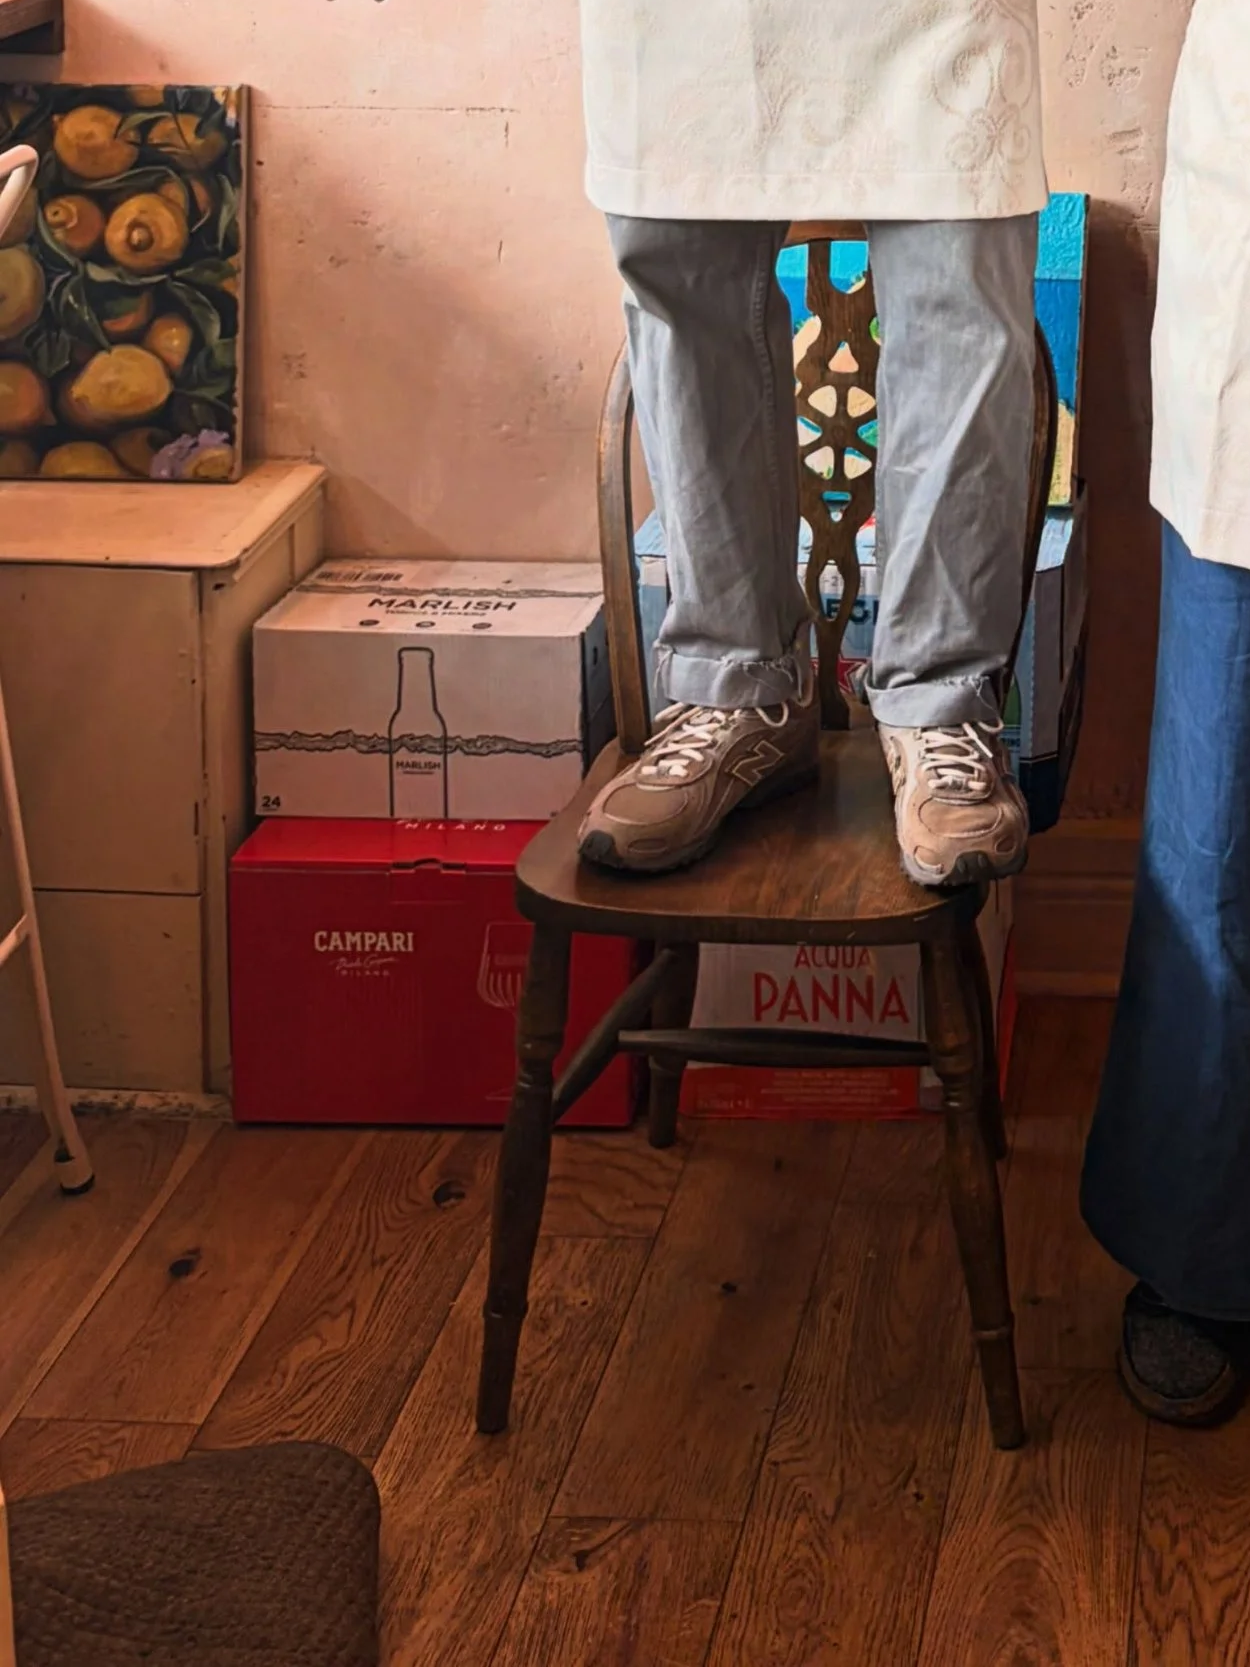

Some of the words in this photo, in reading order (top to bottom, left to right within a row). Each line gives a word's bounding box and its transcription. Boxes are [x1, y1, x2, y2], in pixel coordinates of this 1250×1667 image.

[368, 597, 517, 611] MARLISH
[395, 760, 441, 770] MARLISH
[262, 796, 281, 808] 24
[405, 822, 507, 831] MILANO
[314, 931, 414, 952] CAMPARI
[794, 945, 872, 969] ACQUA
[754, 972, 910, 1023] PANNA
